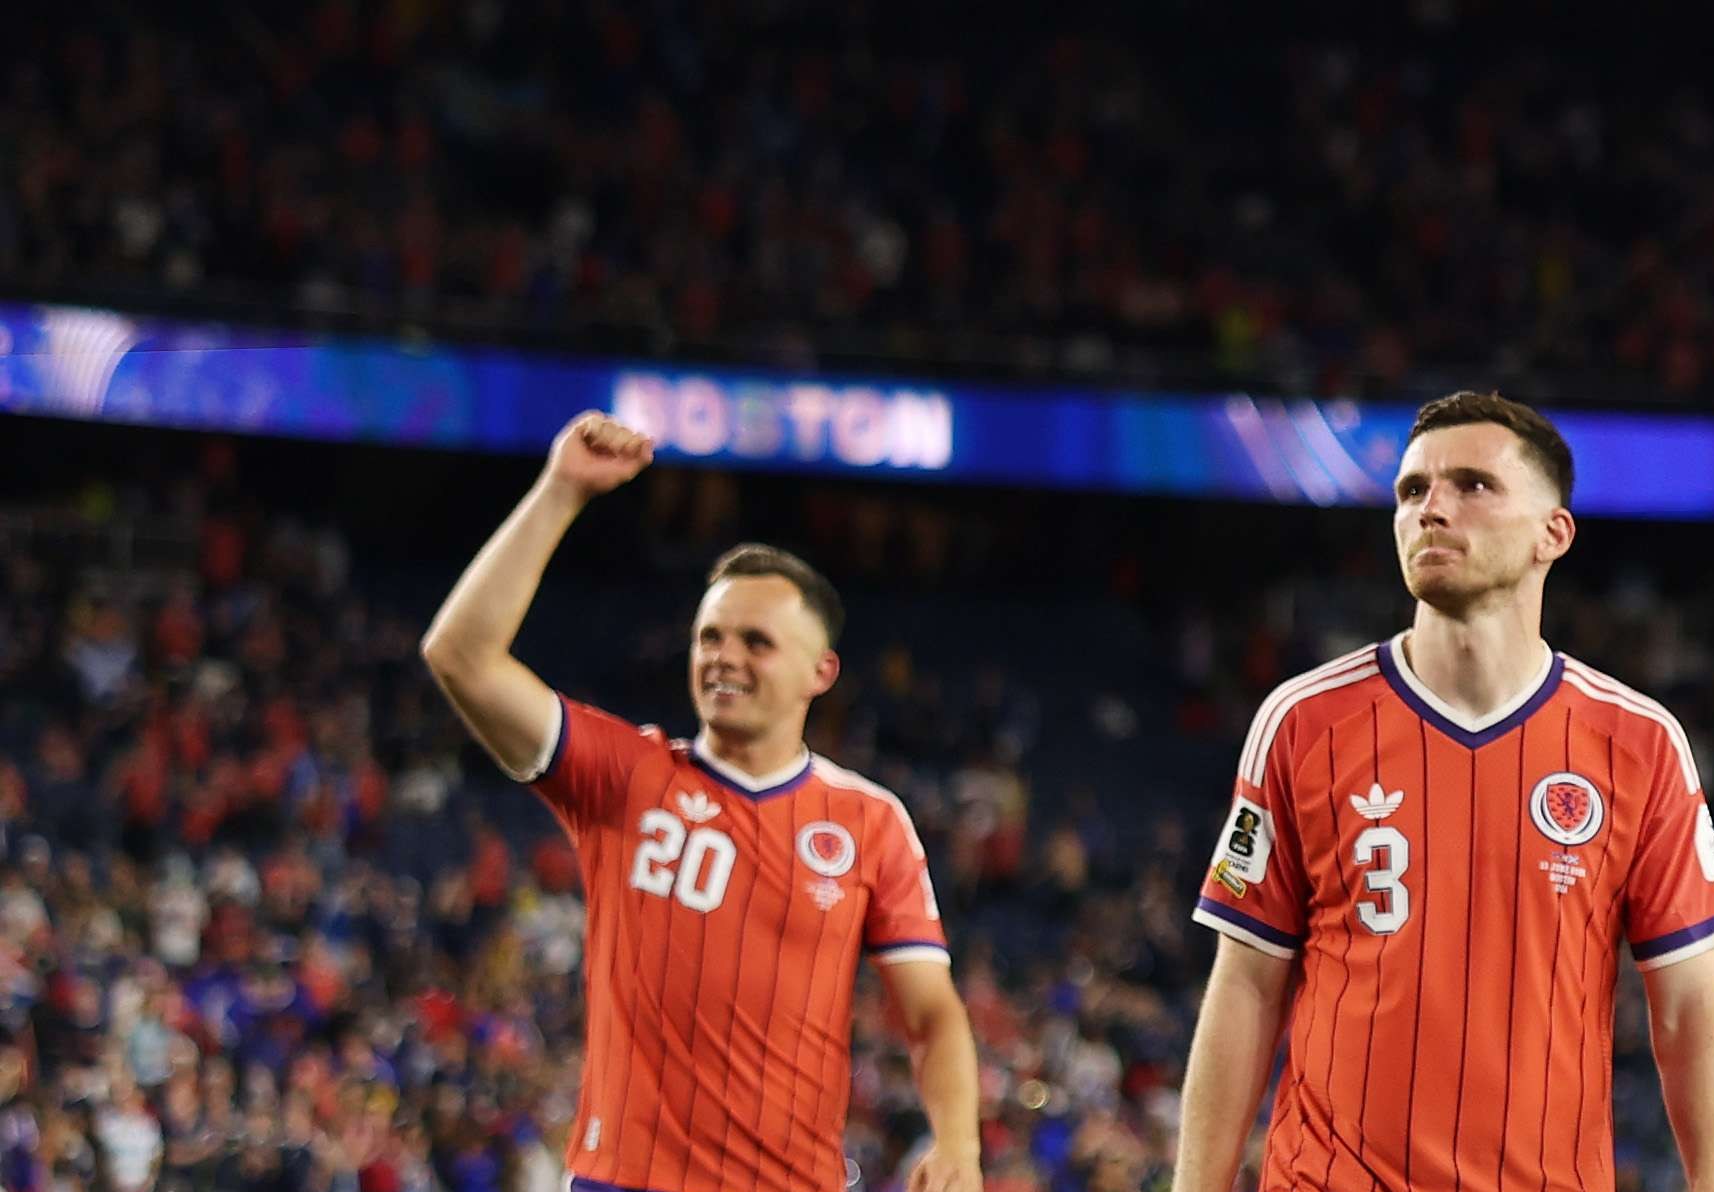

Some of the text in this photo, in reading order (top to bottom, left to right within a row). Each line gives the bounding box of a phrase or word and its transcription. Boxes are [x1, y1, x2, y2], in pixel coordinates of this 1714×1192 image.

[613, 373, 952, 468] BOSTON
[629, 807, 737, 914] 20
[1354, 826, 1409, 935] 3
